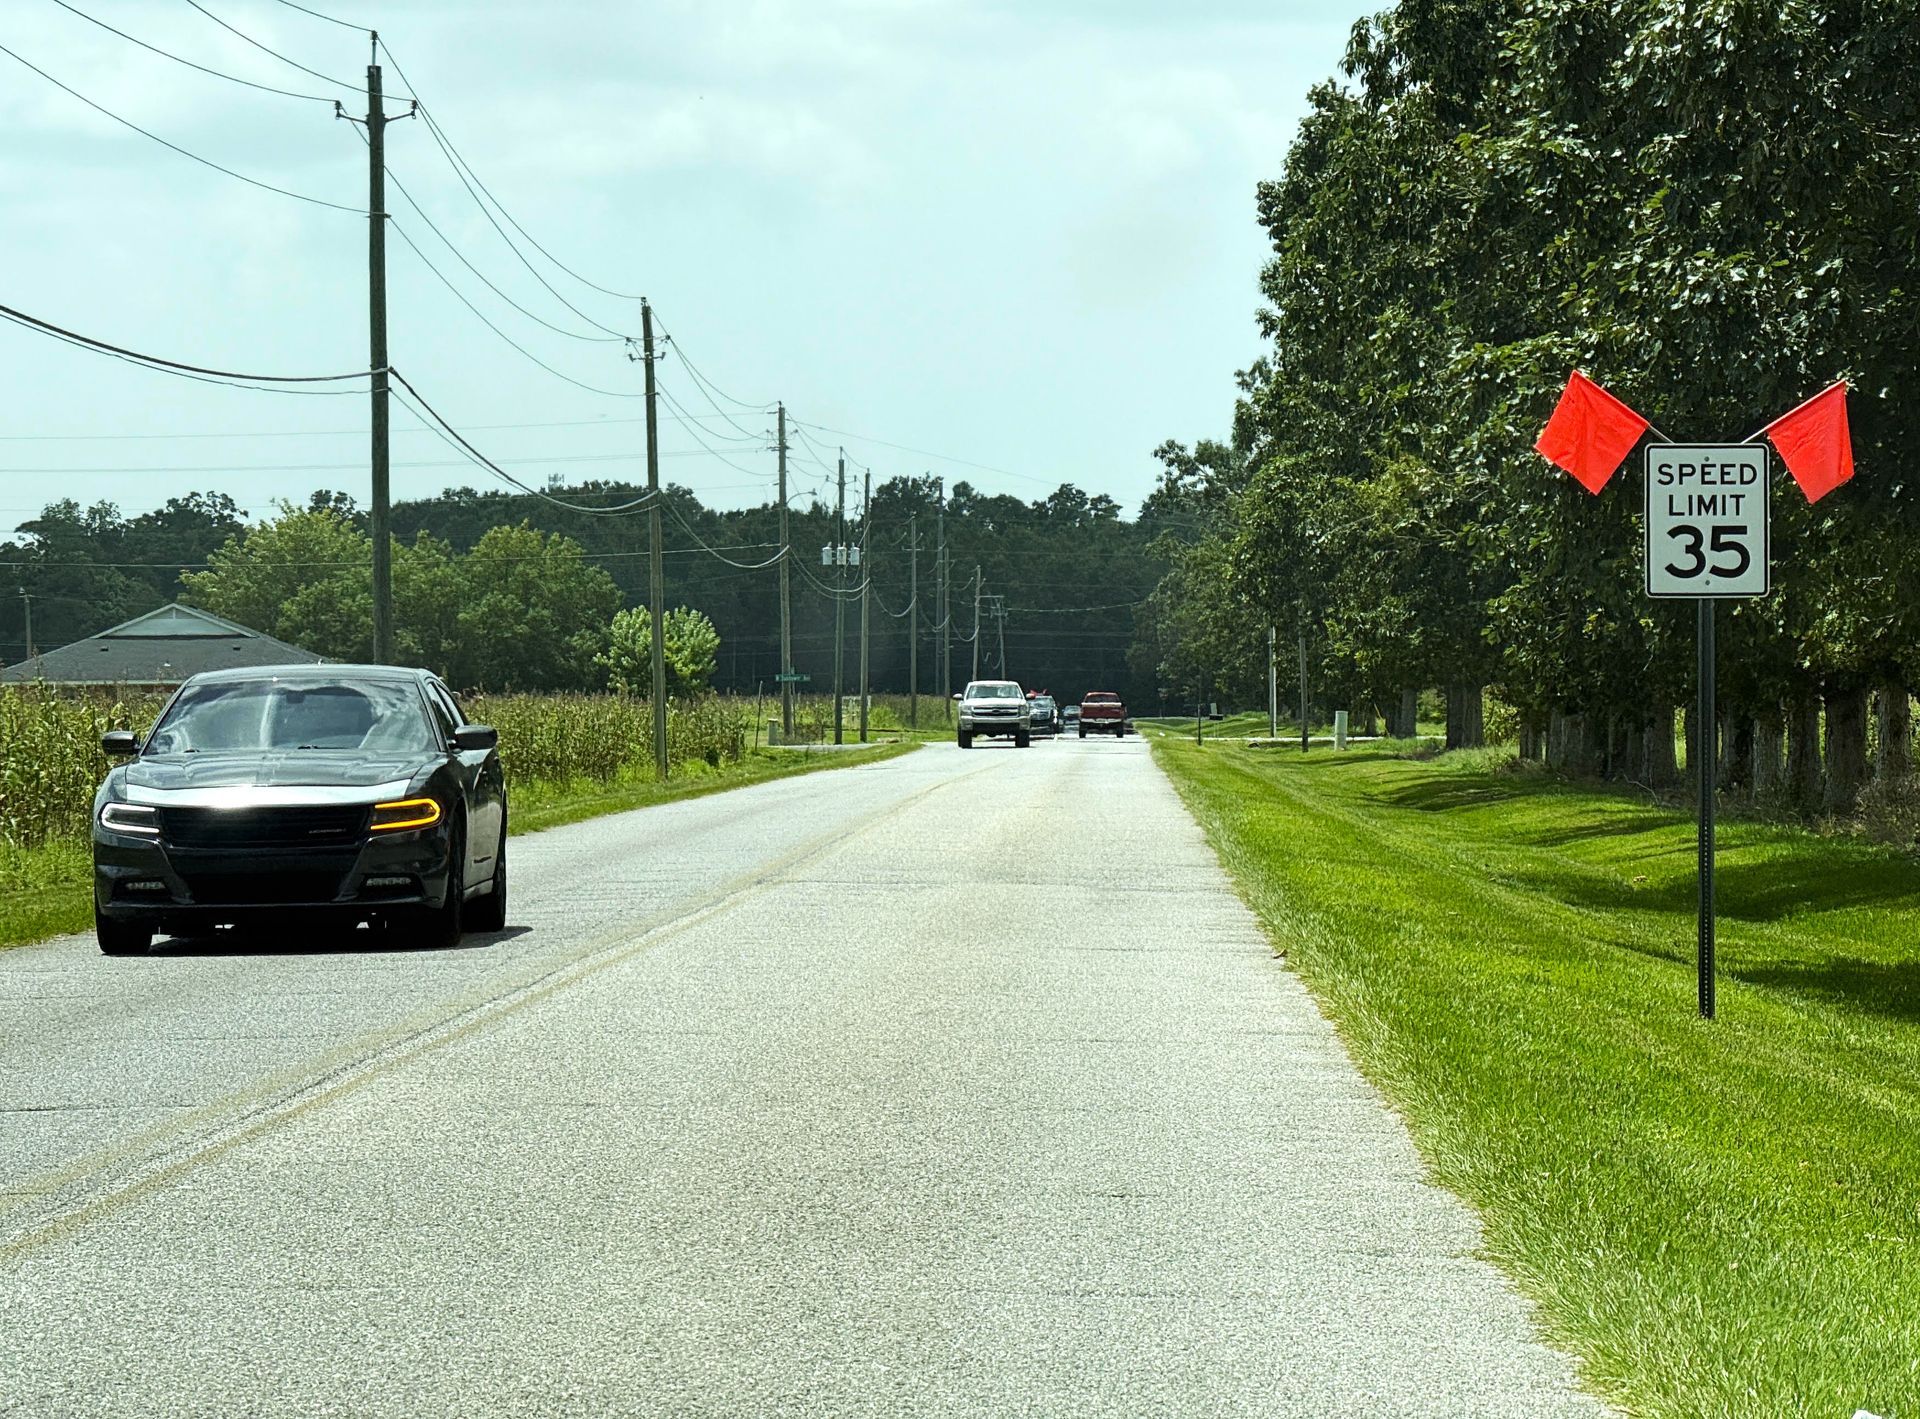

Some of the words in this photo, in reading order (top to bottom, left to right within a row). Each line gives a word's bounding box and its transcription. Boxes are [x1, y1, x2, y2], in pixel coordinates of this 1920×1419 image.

[1657, 463, 1758, 486] SPEED
[1668, 494, 1746, 517] LIMIT
[1664, 524, 1751, 579] 35
